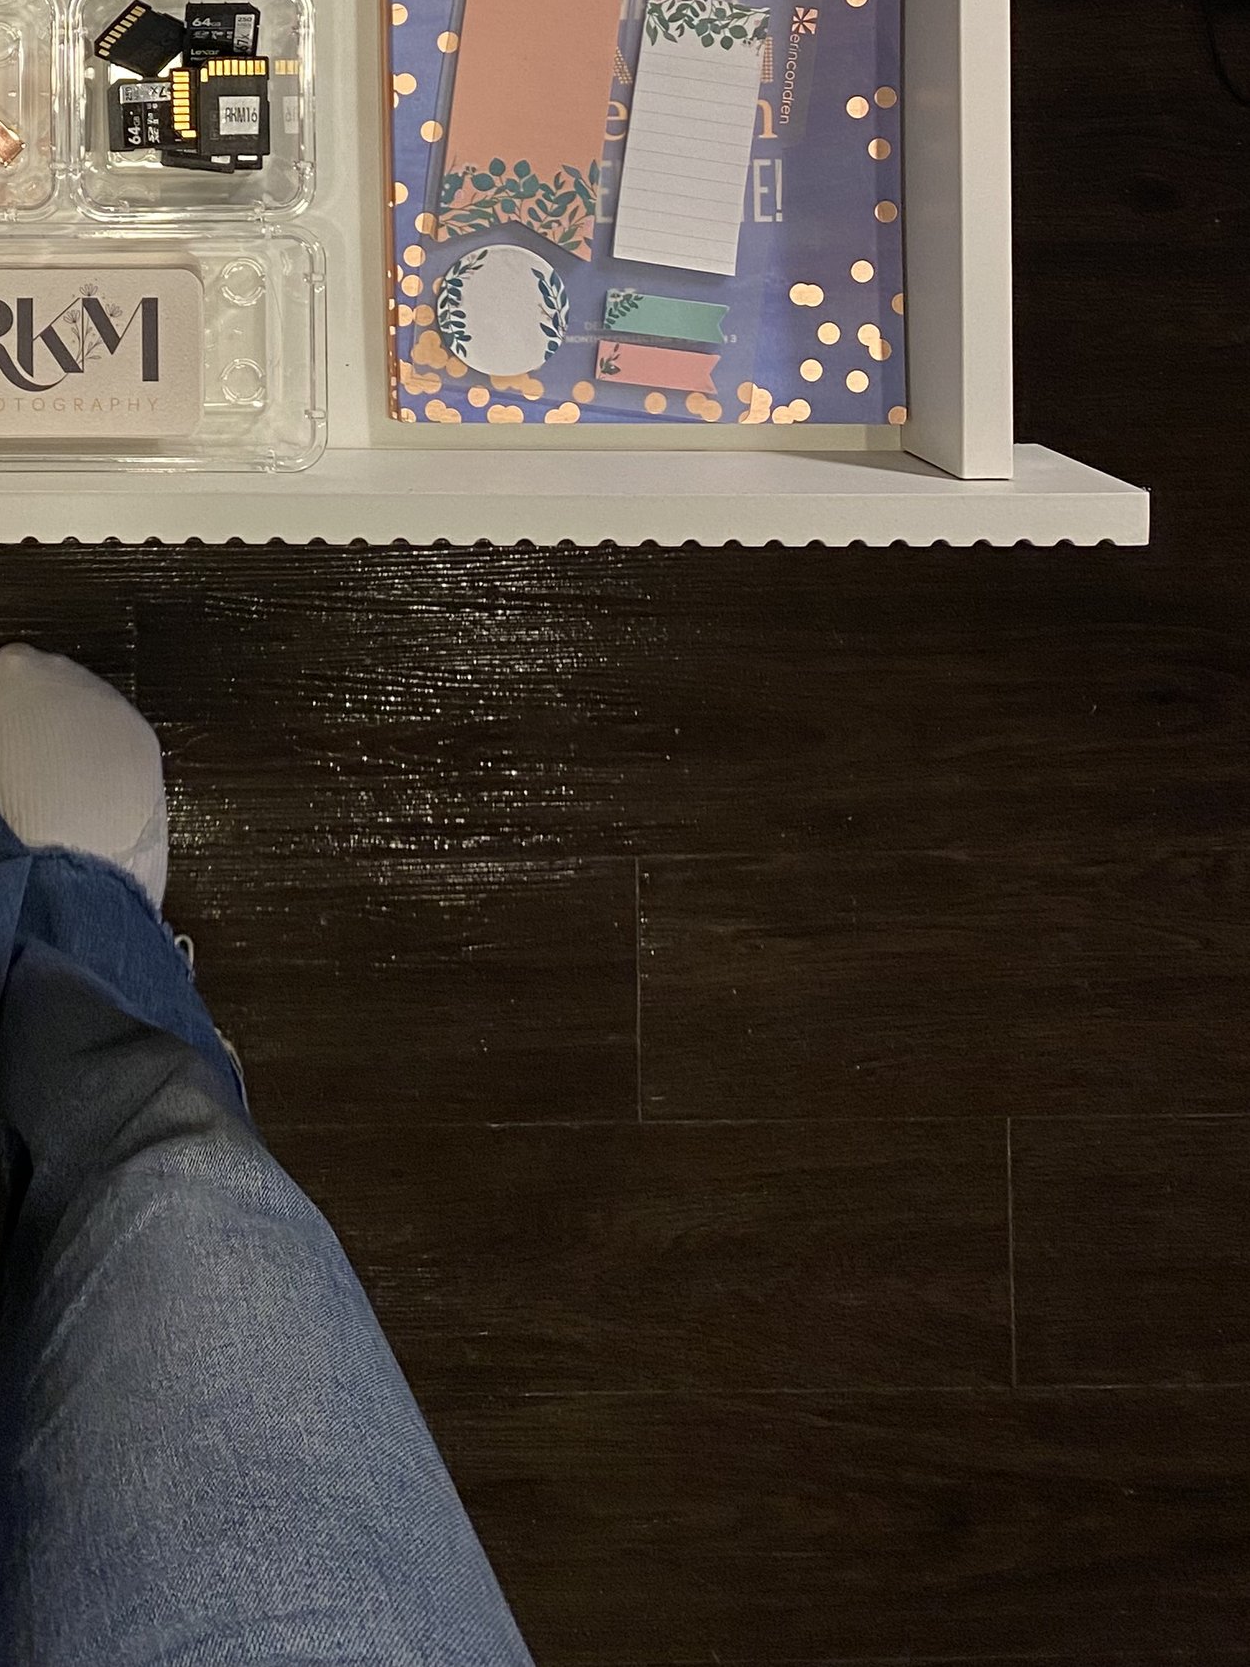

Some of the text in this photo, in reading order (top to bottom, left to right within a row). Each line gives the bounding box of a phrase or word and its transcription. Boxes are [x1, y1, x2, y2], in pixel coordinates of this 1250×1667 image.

[190, 48, 220, 56] Lexar
[779, 33, 801, 125] erincondren
[225, 106, 258, 123] RKM16
